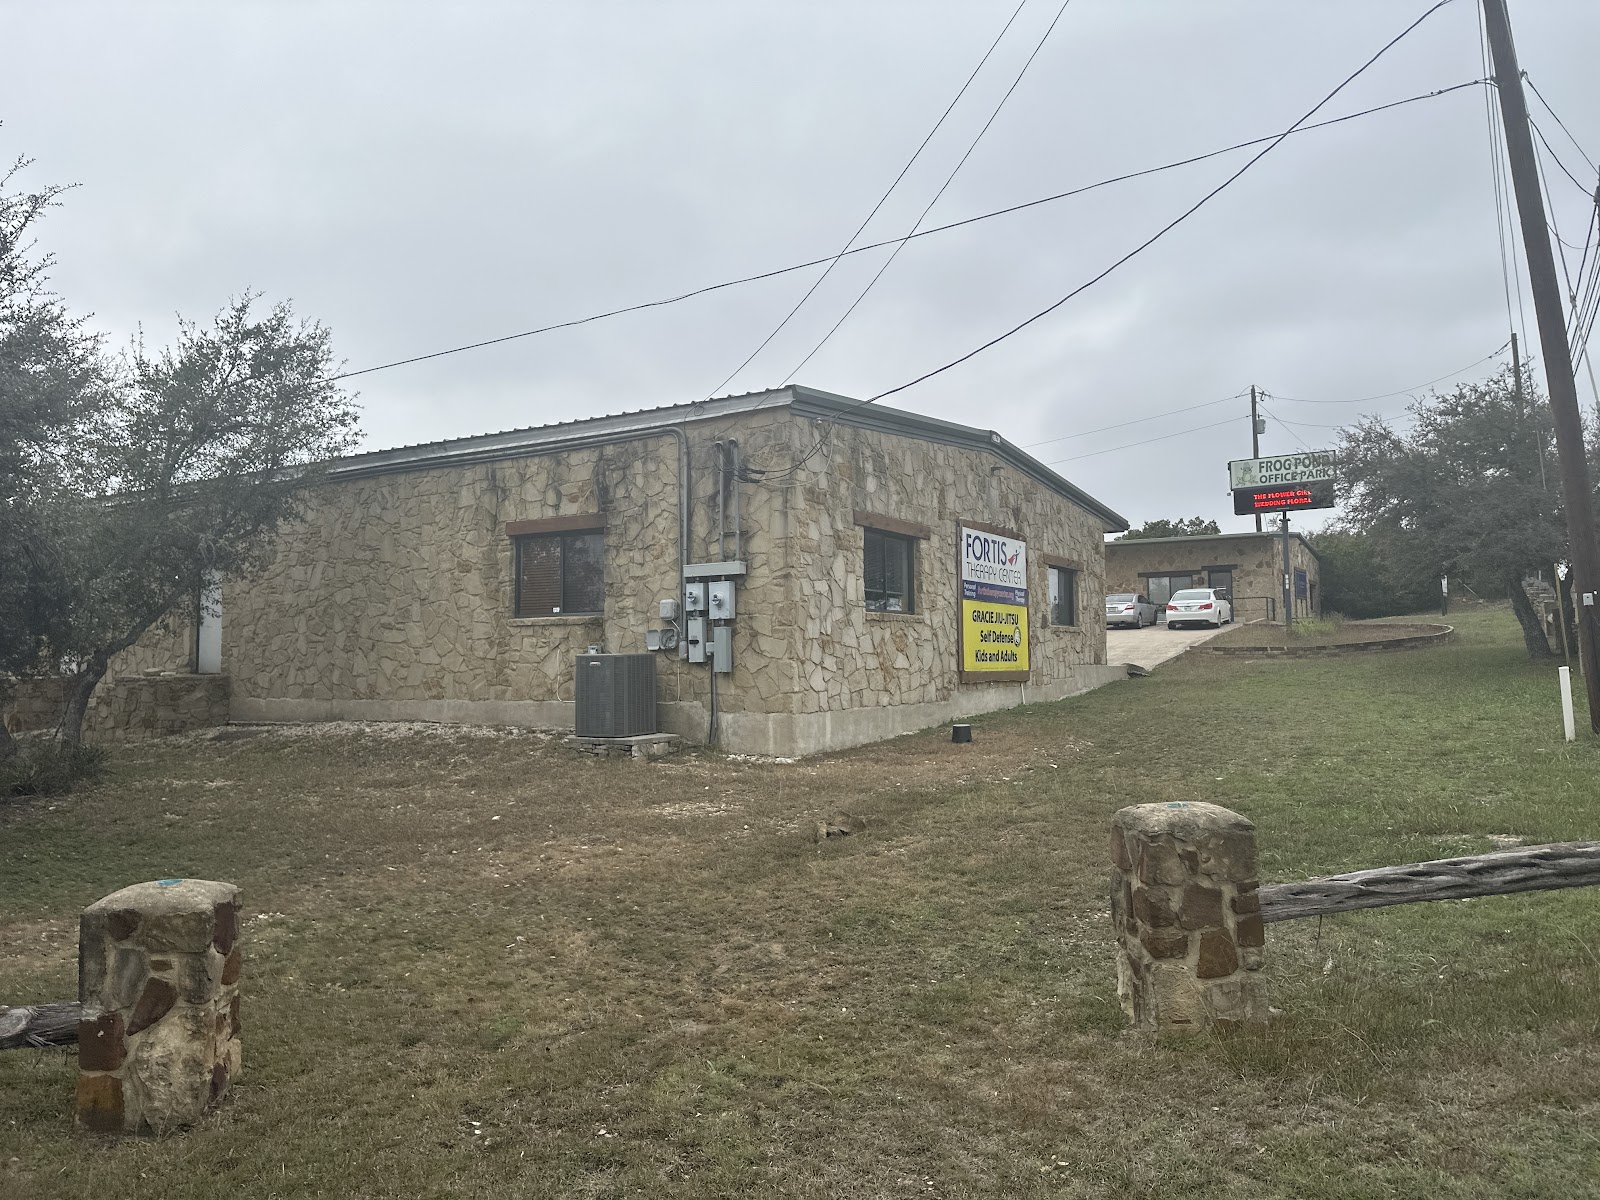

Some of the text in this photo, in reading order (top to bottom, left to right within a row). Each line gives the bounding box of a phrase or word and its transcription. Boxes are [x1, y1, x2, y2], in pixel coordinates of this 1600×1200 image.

[1258, 458, 1291, 473] FROG
[1259, 468, 1332, 484] OFFICE PARK
[1268, 491, 1295, 499] FLOWER
[1254, 499, 1286, 508] WEDDING
[966, 533, 1007, 566] FORTIS
[966, 561, 1021, 585] THERAPY CENTER
[972, 609, 1018, 625] GRACIE JIU-JITSU
[980, 630, 1014, 644] Self Defense
[975, 649, 1018, 662] Kids and Adults
